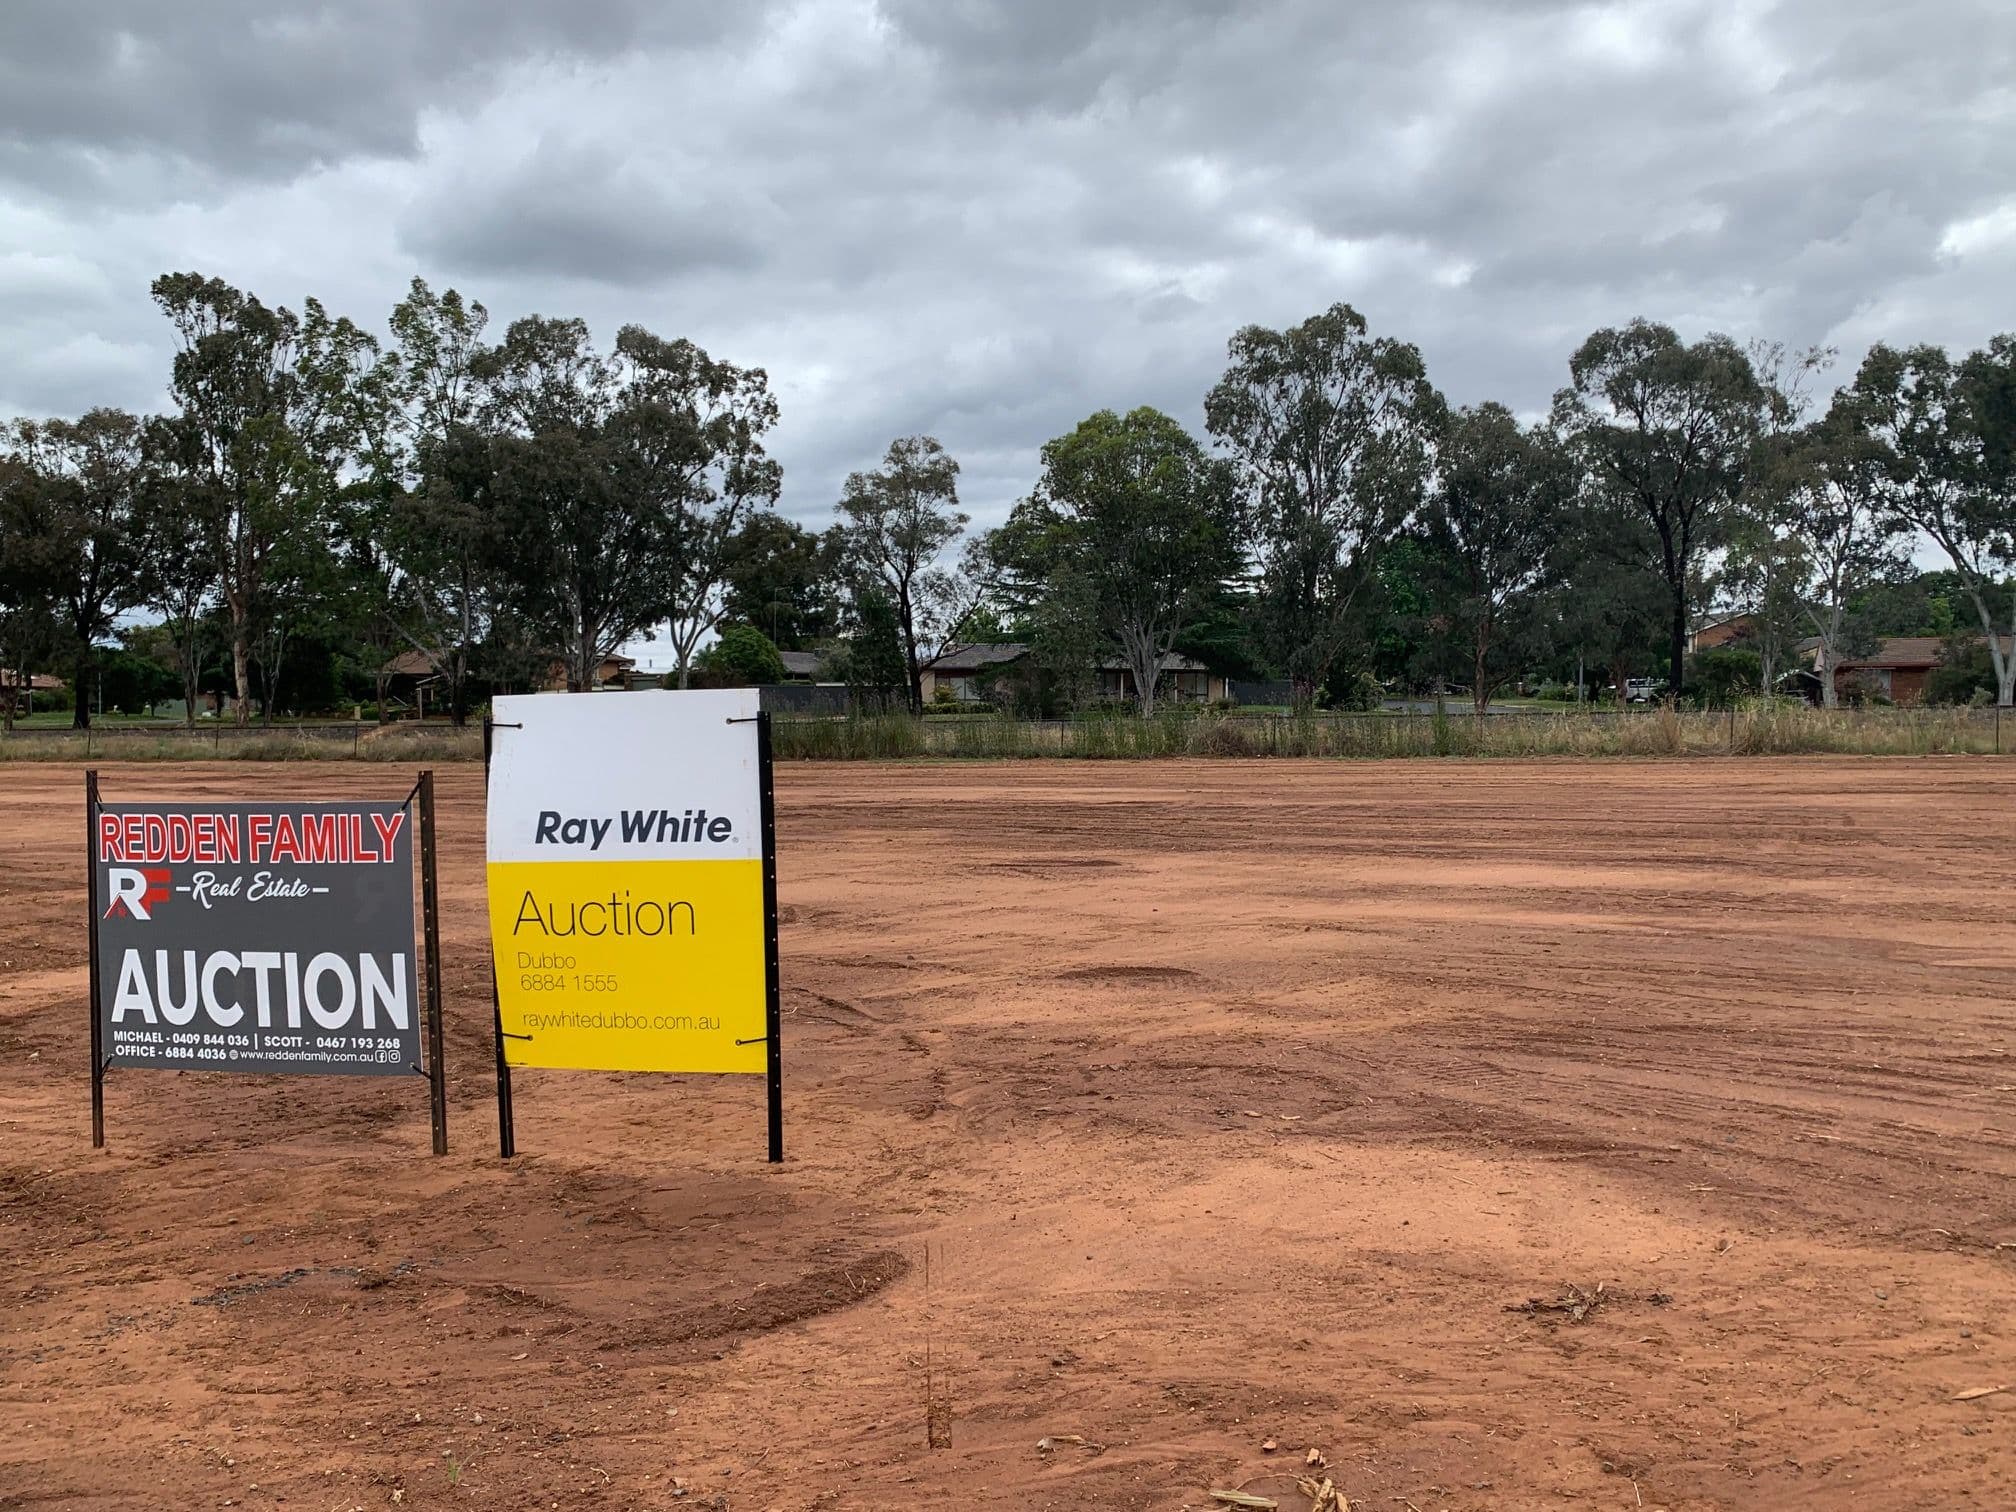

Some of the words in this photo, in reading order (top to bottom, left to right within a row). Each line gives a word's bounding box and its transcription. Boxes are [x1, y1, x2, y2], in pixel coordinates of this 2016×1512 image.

[100, 813, 240, 863] REDDEN
[247, 813, 406, 863] FAMILY
[535, 811, 611, 850] Ray
[621, 810, 732, 843] White
[103, 868, 172, 920] RF
[192, 871, 241, 909] Real
[247, 871, 310, 901] Estate
[513, 890, 695, 936] Auction
[518, 951, 576, 969] Dubbo
[110, 949, 409, 1029] AUCTION
[521, 974, 566, 991] 6884
[574, 975, 618, 991] 1555
[113, 1030, 164, 1043] MICHAEL
[172, 1033, 200, 1044] 0409
[203, 1034, 225, 1045] 844
[227, 1035, 249, 1046] 036
[264, 1036, 302, 1047] SCOTT
[316, 1037, 346, 1048] 0467
[351, 1038, 373, 1049] 193
[377, 1038, 400, 1049] 268
[523, 1011, 720, 1032] raywhitedubbo.com.au
[115, 1045, 156, 1057] OFFICE
[165, 1047, 194, 1058] 6884
[197, 1048, 226, 1060] 4036
[240, 1050, 374, 1063] www.reddenfamily.com.au
